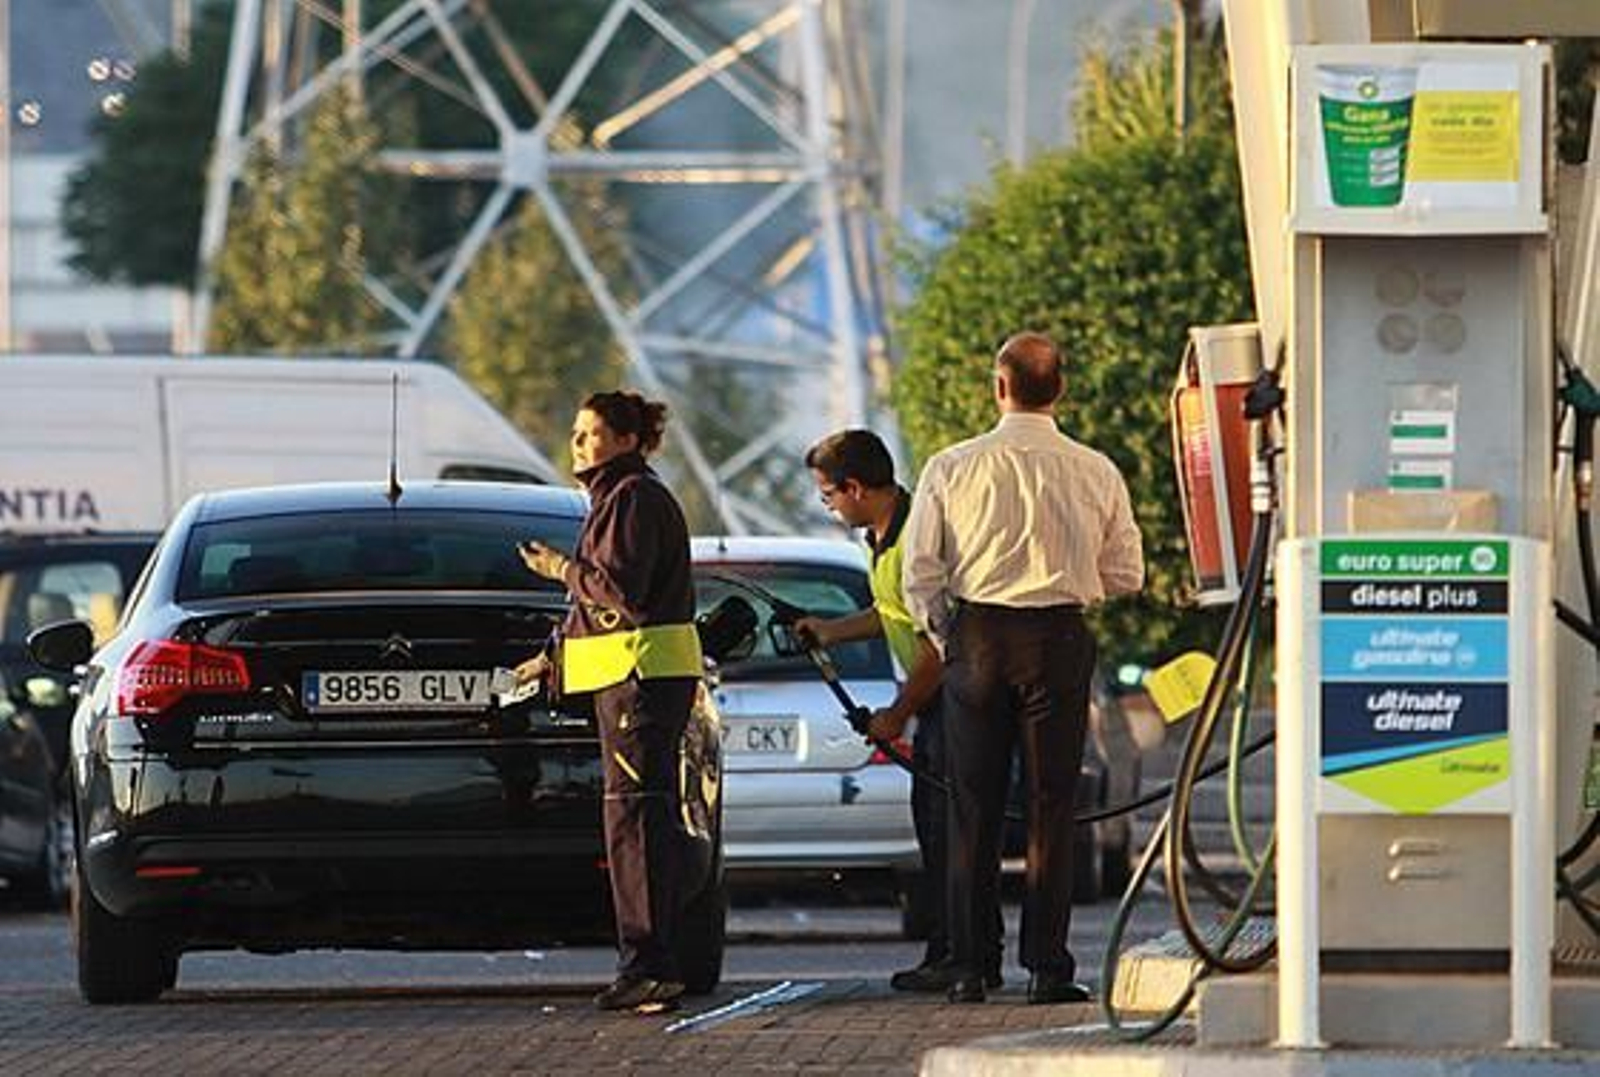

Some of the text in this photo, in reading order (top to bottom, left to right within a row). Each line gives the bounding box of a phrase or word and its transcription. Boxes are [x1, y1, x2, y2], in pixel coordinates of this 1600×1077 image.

[0, 488, 99, 520] NTIA
[1337, 554, 1392, 571] euro
[1397, 554, 1463, 575] super
[1351, 584, 1478, 608] diesel plus
[325, 675, 477, 702] 9856 GLV
[1366, 690, 1463, 712] ultimate
[1373, 711, 1455, 731] diesel
[746, 725, 794, 750] CKY
